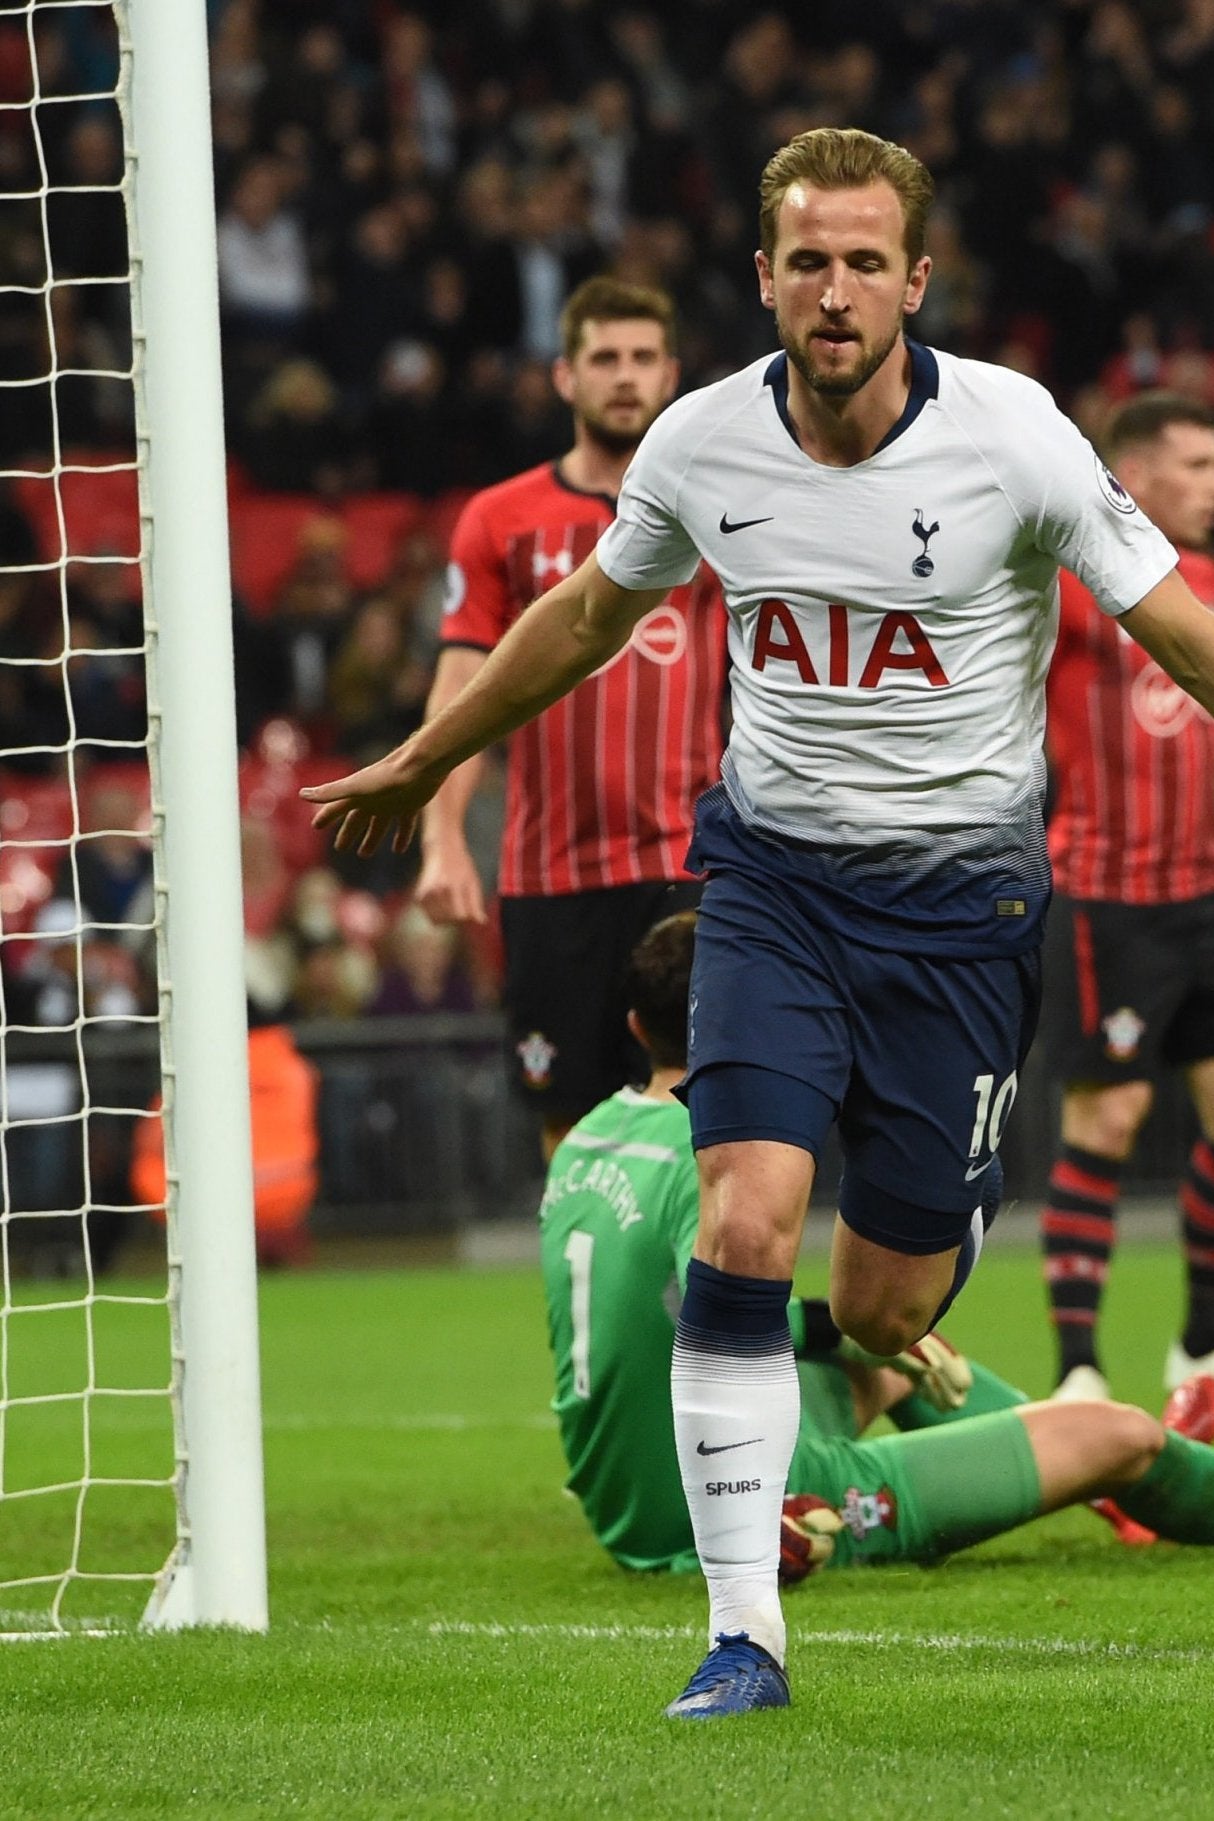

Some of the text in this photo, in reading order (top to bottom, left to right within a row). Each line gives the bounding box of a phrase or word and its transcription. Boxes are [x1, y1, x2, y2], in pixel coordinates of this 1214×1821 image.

[752, 598, 950, 689] AIA
[968, 1069, 1018, 1158] 10
[564, 1230, 594, 1399] 1
[705, 1478, 761, 1496] SPURS
